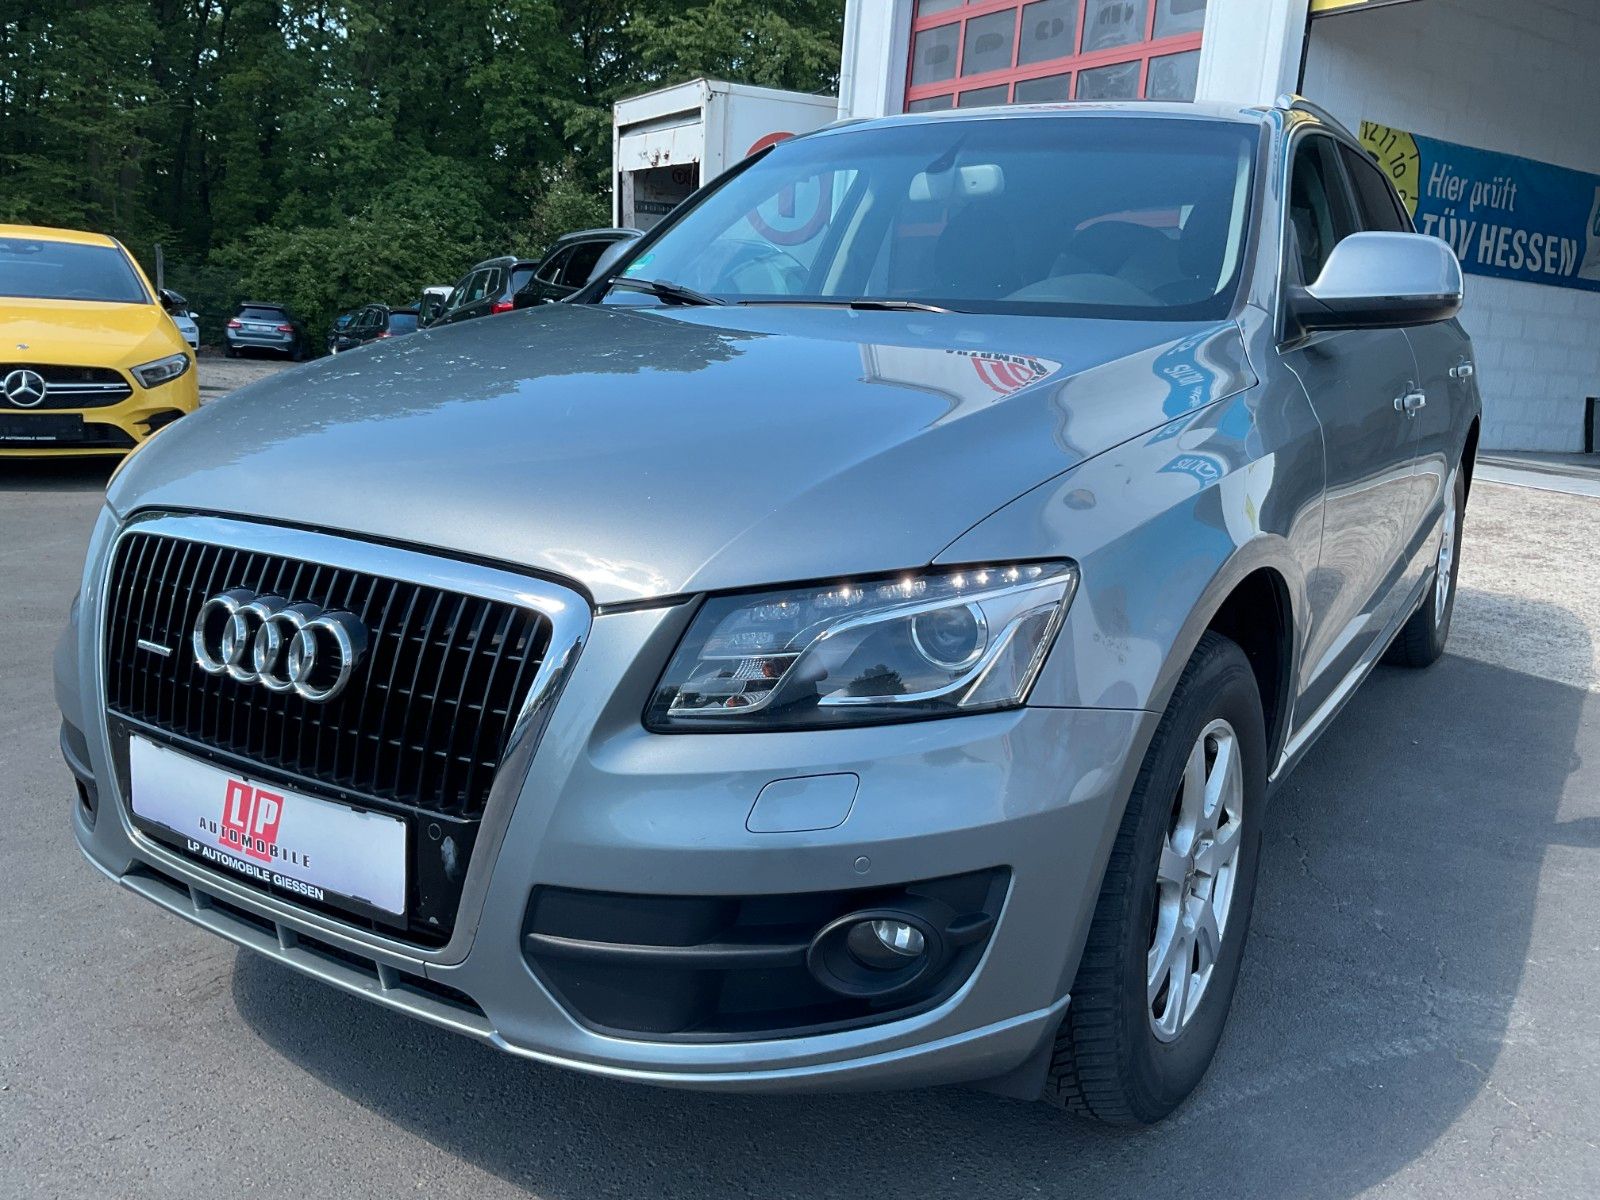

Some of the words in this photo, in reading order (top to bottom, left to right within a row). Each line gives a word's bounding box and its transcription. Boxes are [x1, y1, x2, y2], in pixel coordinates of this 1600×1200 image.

[1390, 152, 1407, 178] 10
[1427, 162, 1468, 201] Hier
[1469, 176, 1518, 213] prüft
[1422, 208, 1477, 261] TÜV
[1477, 223, 1578, 277] HESSEN
[228, 785, 281, 835] LP
[199, 816, 311, 868] AUTOMOBILE
[187, 838, 201, 851] LP
[202, 846, 271, 882] AUTOMOBILE
[273, 874, 324, 901] GIESSEN
